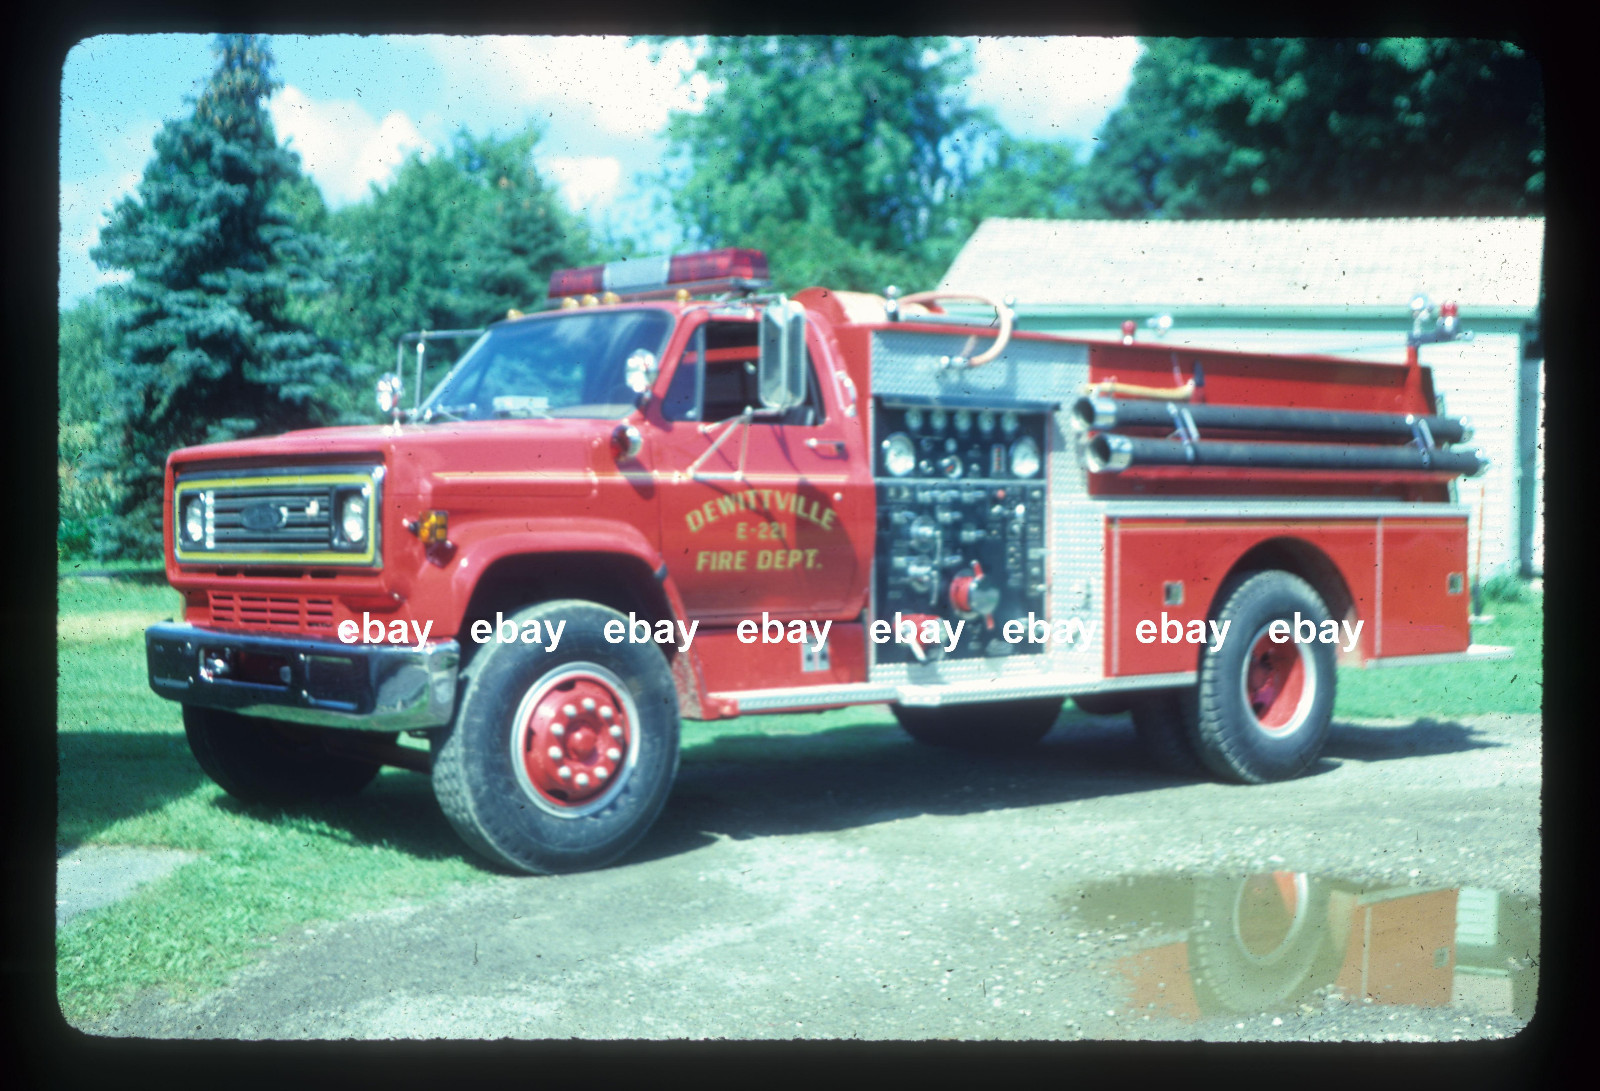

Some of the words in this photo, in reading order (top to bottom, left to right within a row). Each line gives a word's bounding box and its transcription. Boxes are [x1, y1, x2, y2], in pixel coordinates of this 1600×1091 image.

[685, 489, 837, 532] DEWITTVILLE
[736, 522, 787, 540] E-221
[696, 551, 747, 571] FIRE
[756, 549, 823, 570] DEPT.
